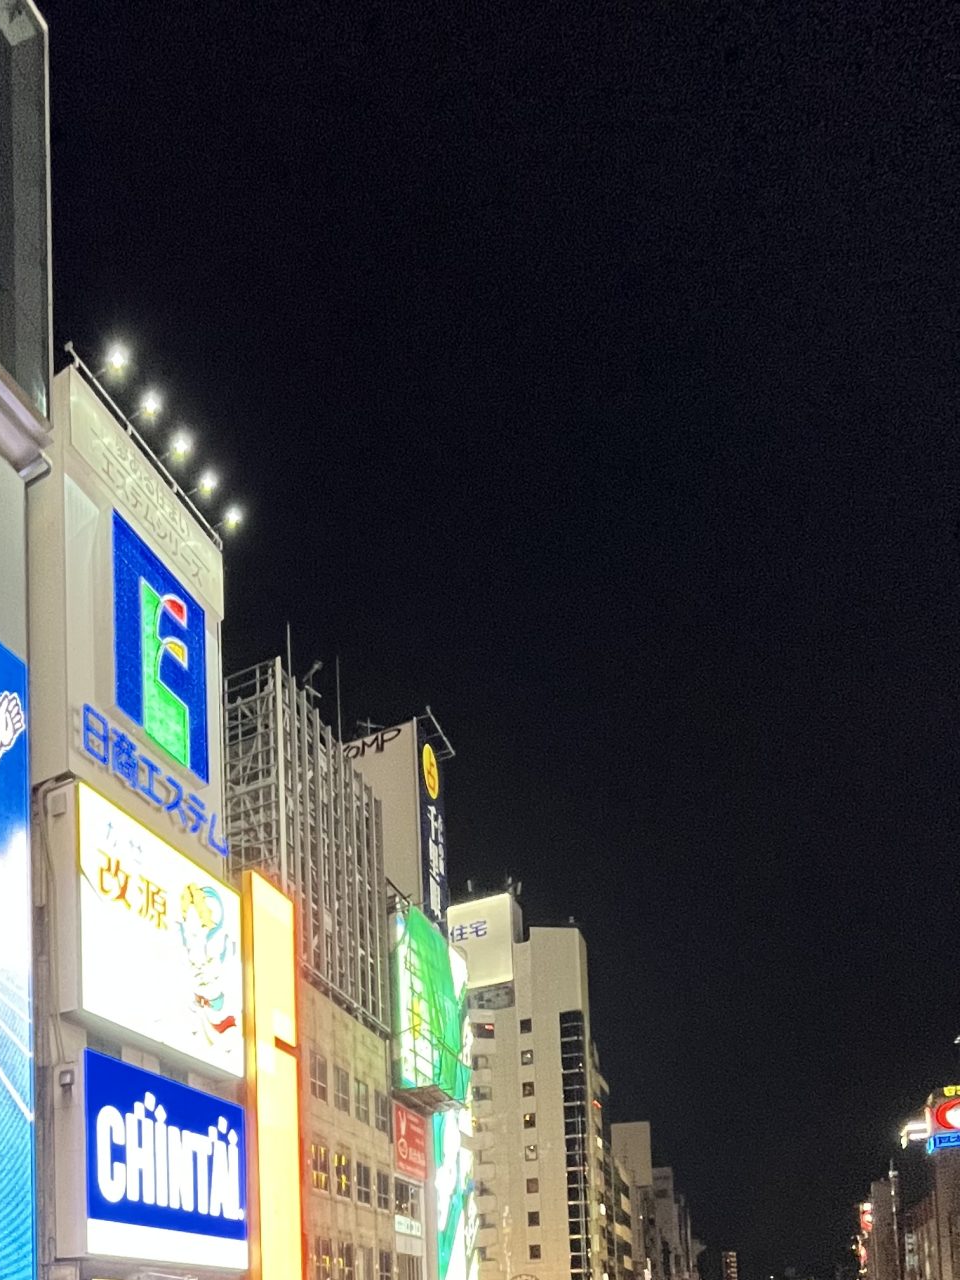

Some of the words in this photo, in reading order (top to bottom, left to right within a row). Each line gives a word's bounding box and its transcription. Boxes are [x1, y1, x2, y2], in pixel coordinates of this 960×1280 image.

[101, 451, 204, 588] エステムシリーズ
[343, 728, 402, 759] OMP
[97, 849, 168, 931] 改源
[450, 920, 488, 943] 住宅
